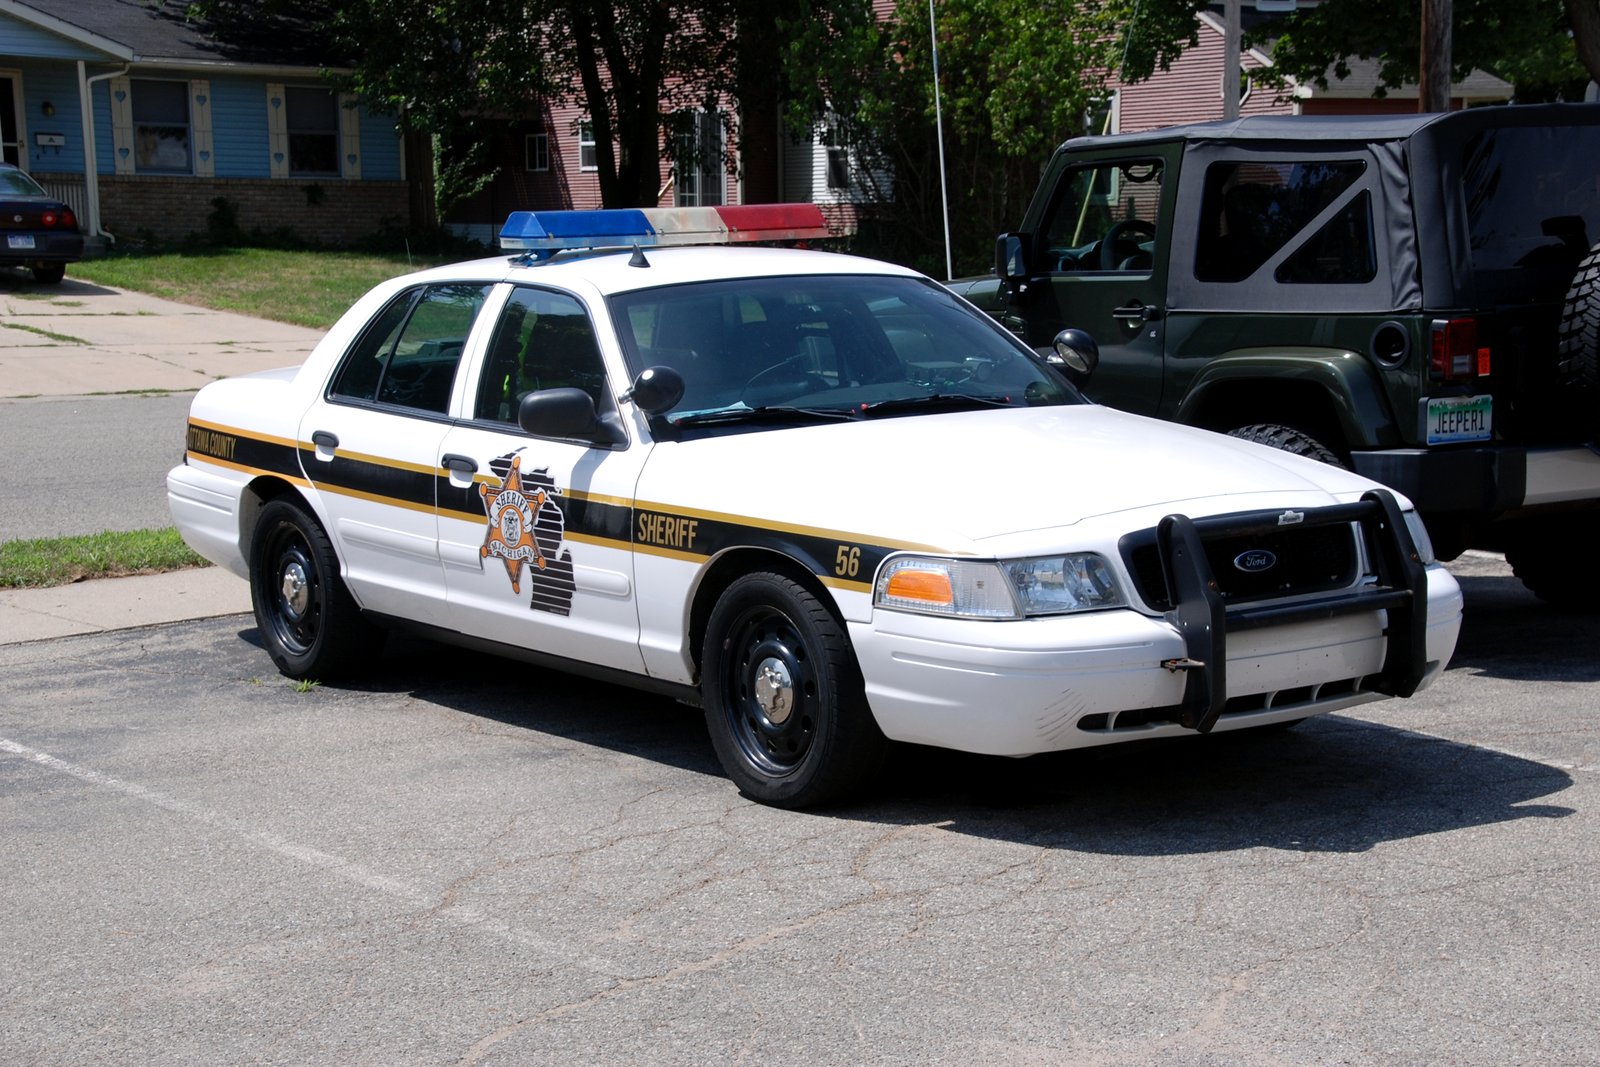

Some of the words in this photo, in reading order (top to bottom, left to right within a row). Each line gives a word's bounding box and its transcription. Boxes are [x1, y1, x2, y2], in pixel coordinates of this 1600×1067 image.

[1435, 409, 1484, 434] JEEPER1
[209, 433, 237, 460] COUNTY
[495, 491, 531, 516] SHERIFF
[638, 513, 698, 548] SHERIFF
[491, 542, 534, 559] MICHIGAN
[835, 545, 861, 577] 56
[1246, 554, 1267, 567] Ford
